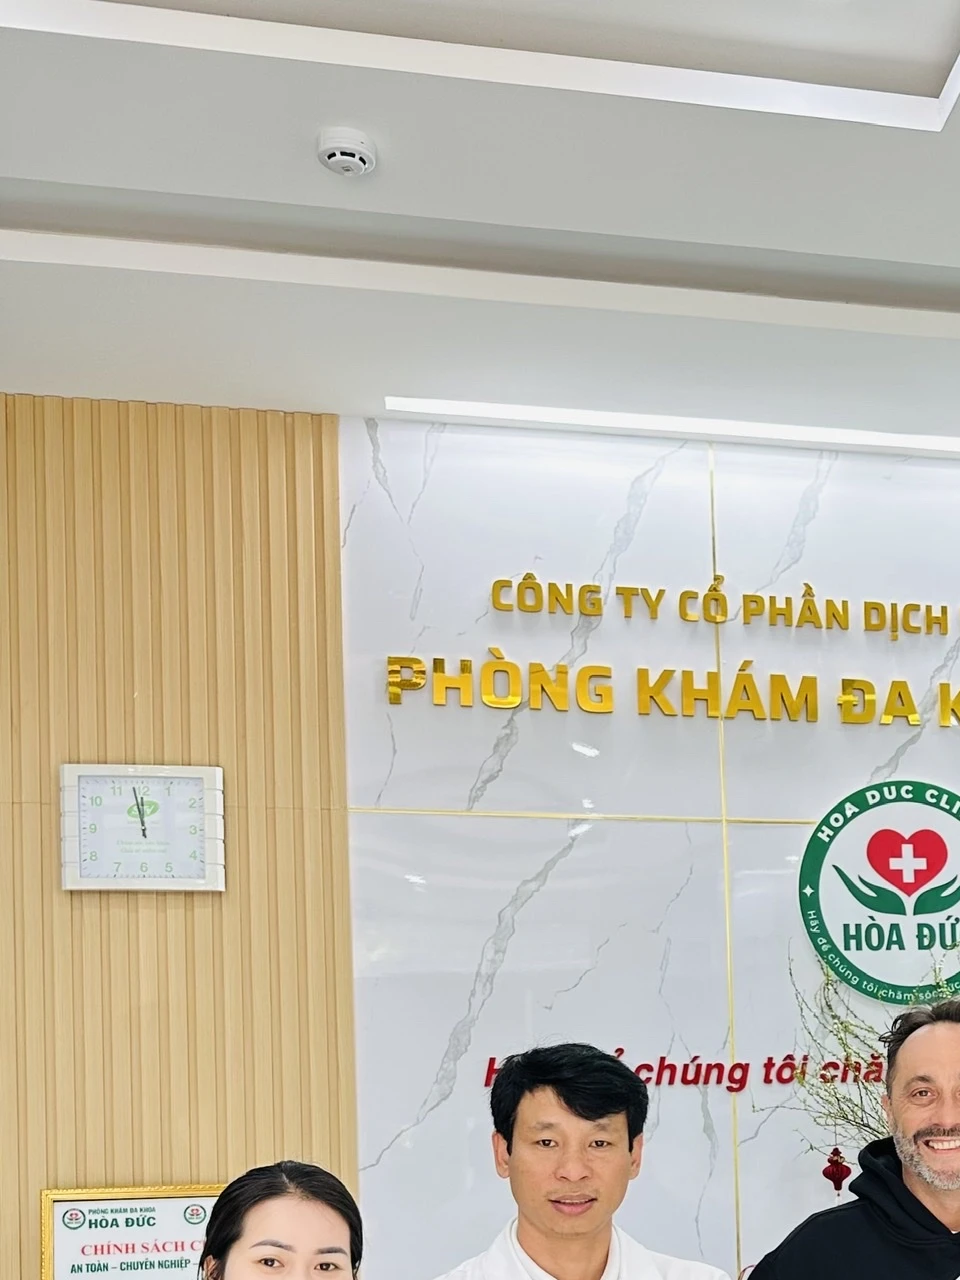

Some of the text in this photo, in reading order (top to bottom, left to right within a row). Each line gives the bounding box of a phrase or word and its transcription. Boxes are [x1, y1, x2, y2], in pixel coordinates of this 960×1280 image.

[492, 572, 603, 617] CÔNG
[616, 586, 666, 620] TY
[679, 575, 728, 624] CỔ
[743, 583, 849, 630] PHẦN
[863, 601, 948, 640] DỊCH
[387, 647, 613, 714] PHÒNG
[637, 660, 819, 723] KHÁM
[837, 676, 921, 725] ĐA
[111, 787, 122, 795] 11
[138, 786, 149, 795] 12
[90, 796, 102, 806] 10
[189, 799, 197, 808] 2
[817, 801, 860, 843] HOA
[865, 785, 914, 806] DUC
[89, 824, 97, 833] 9
[189, 825, 197, 835] 3
[89, 851, 97, 861] 8
[189, 851, 197, 860] 4
[114, 863, 122, 872] 7
[140, 863, 148, 872] 6
[165, 863, 173, 872] 5
[843, 915, 905, 951] HÒA
[808, 910, 820, 933] Hãy
[828, 953, 859, 985] chúng
[862, 981, 878, 993] tôi
[881, 989, 914, 1000] chăm
[634, 1055, 750, 1092] chúng
[762, 1054, 809, 1084] tôi
[821, 1054, 885, 1083] chă
[88, 1213, 156, 1229] HÒA ĐỨC
[81, 1241, 135, 1256] CHÍNH
[141, 1239, 185, 1253] SÁCH
[71, 1264, 83, 1274] AN
[86, 1260, 109, 1273] TOÀN
[158, 1257, 191, 1270] NGHIỆP
